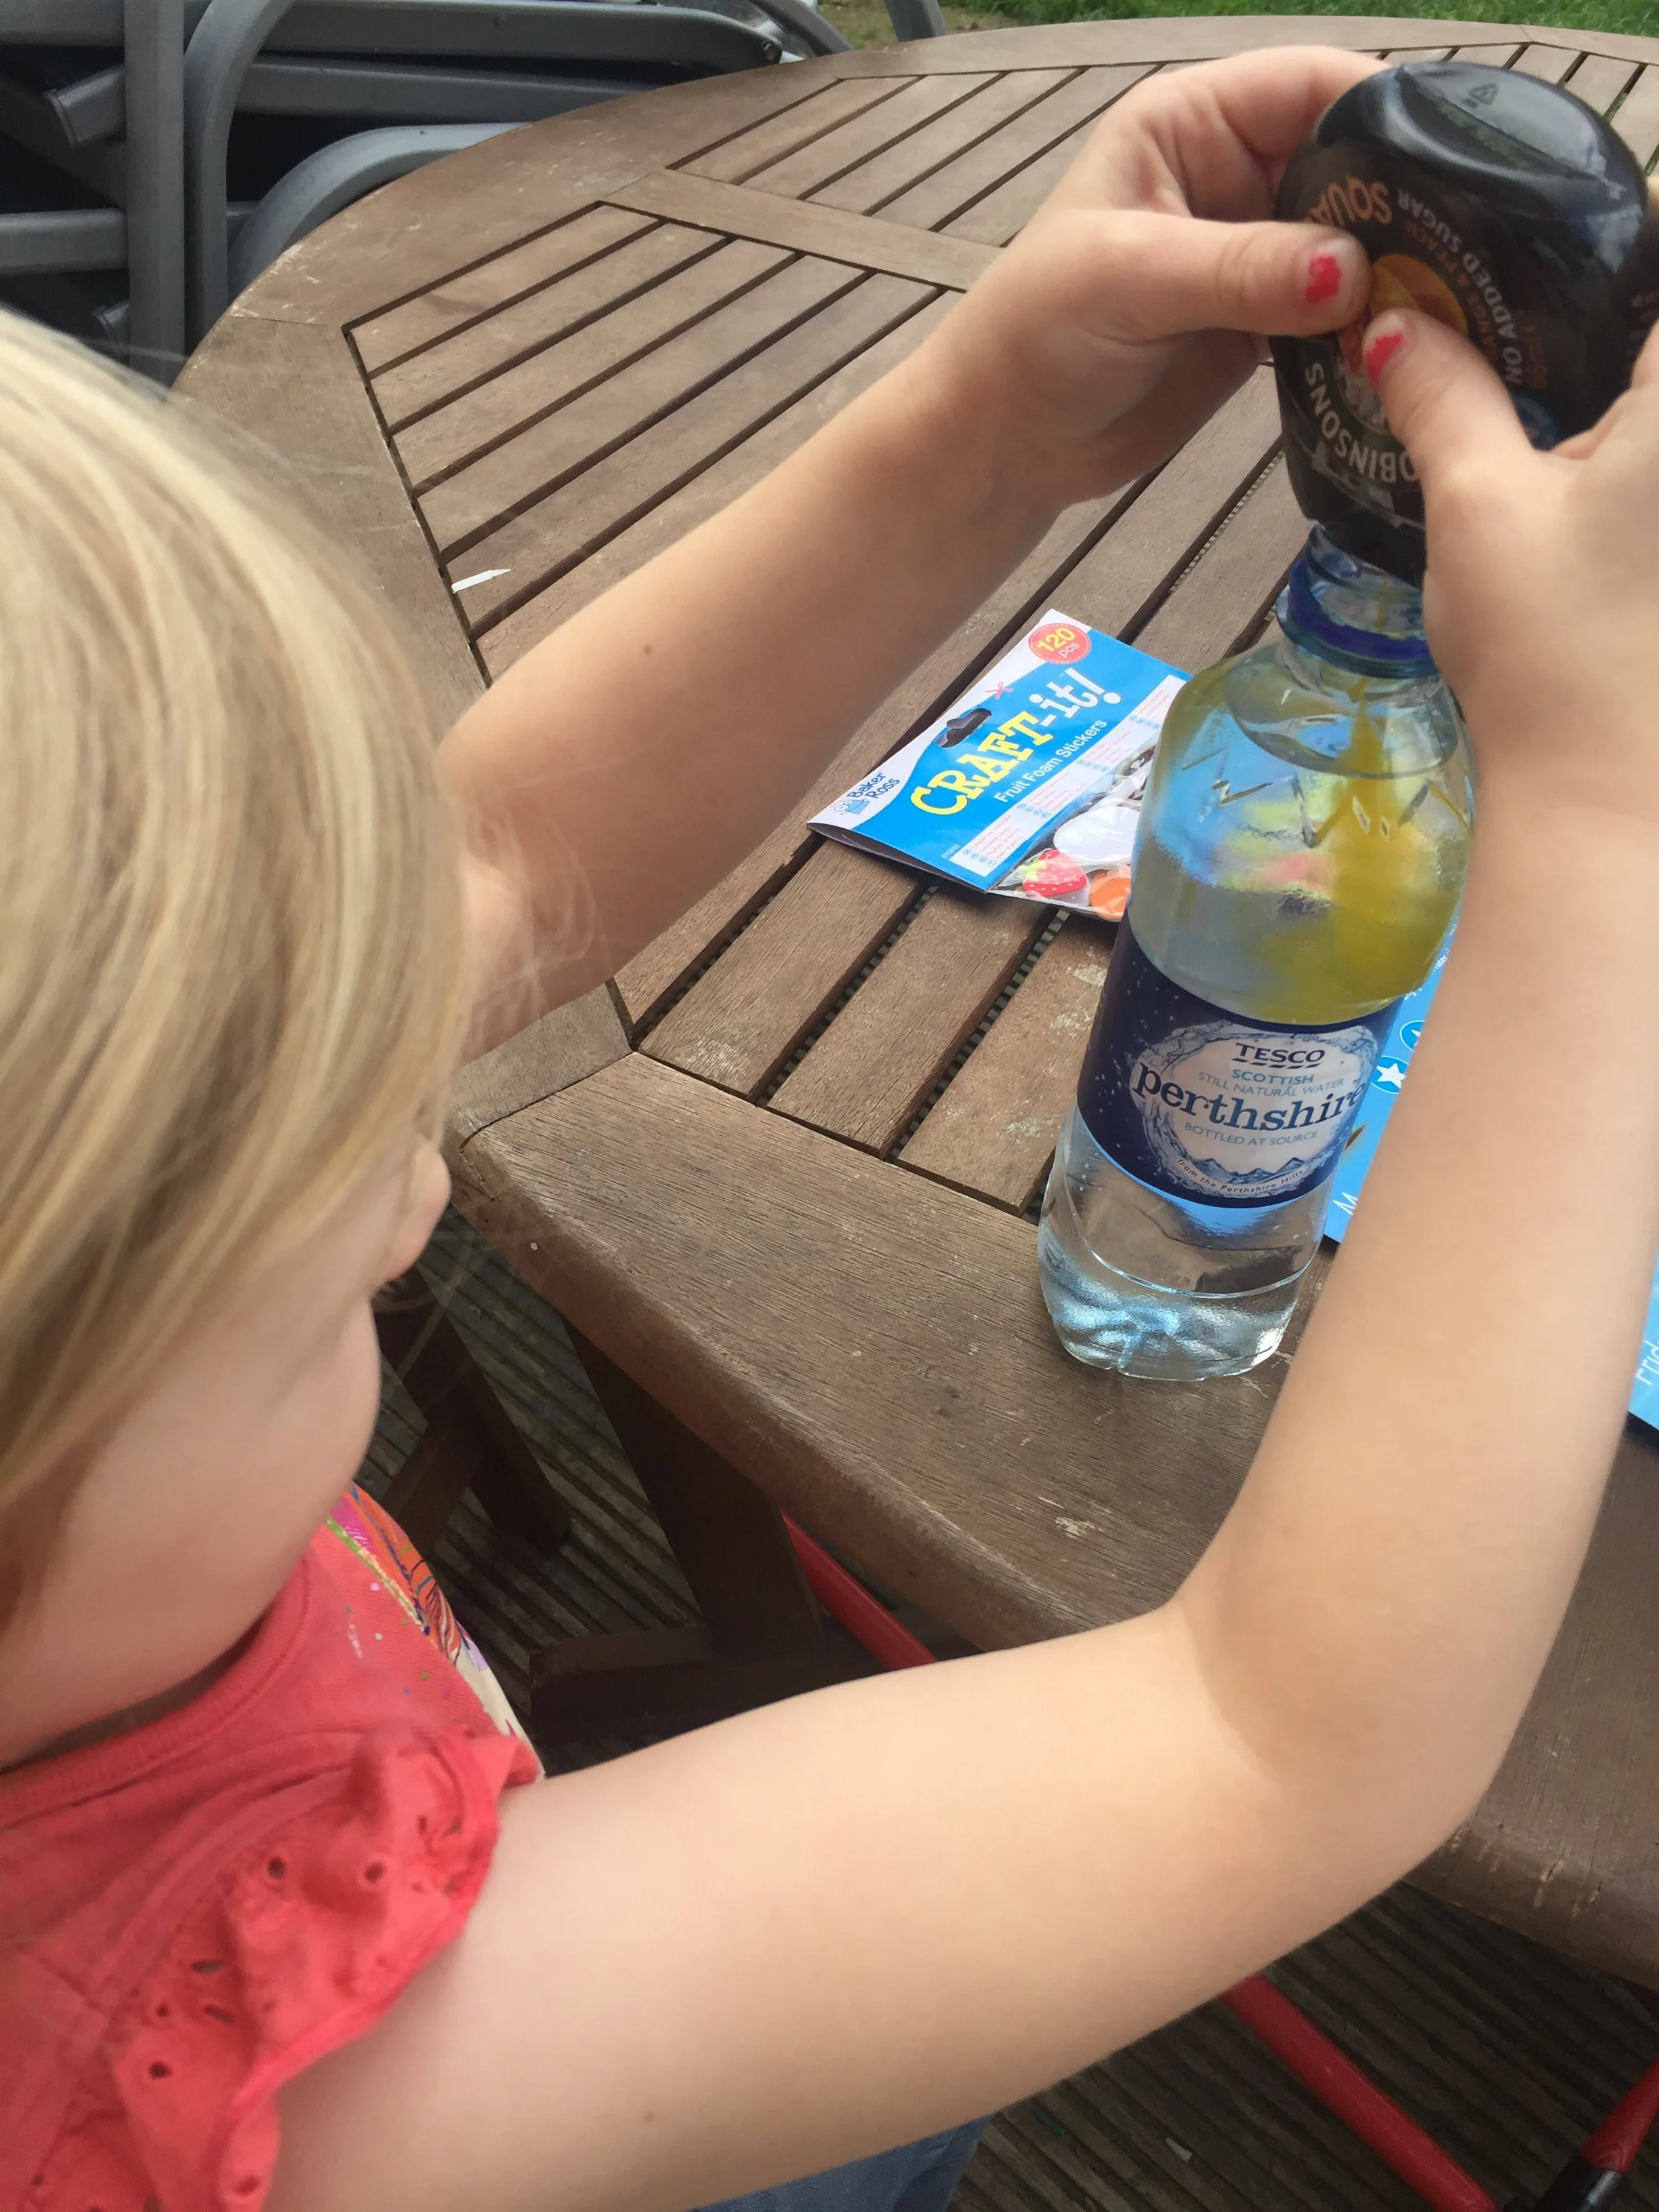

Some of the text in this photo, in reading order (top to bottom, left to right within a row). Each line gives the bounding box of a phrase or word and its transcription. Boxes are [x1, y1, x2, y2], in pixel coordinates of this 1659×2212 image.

[1304, 177, 1393, 227] SQUA
[1397, 189, 1523, 384] NO ADDED SUGAR
[1305, 363, 1417, 483] OBINSONS
[1036, 627, 1076, 653] 120
[1058, 642, 1080, 659] pcs
[994, 779, 1031, 803] Fruit
[1024, 754, 1063, 783] Foam
[1055, 718, 1108, 758] Stickers
[846, 771, 886, 800] Baker
[868, 776, 901, 801] Ross
[1235, 1042, 1326, 1064] TESCO
[1198, 1071, 1344, 1097] STILL NATURAL WATER
[1231, 1069, 1315, 1085] SCOTTISH
[1132, 1061, 1366, 1131] perthshire
[1184, 1122, 1319, 1146] BOTTLED AT SOURCE
[1176, 1158, 1303, 1193] from the Perthshire Hills
